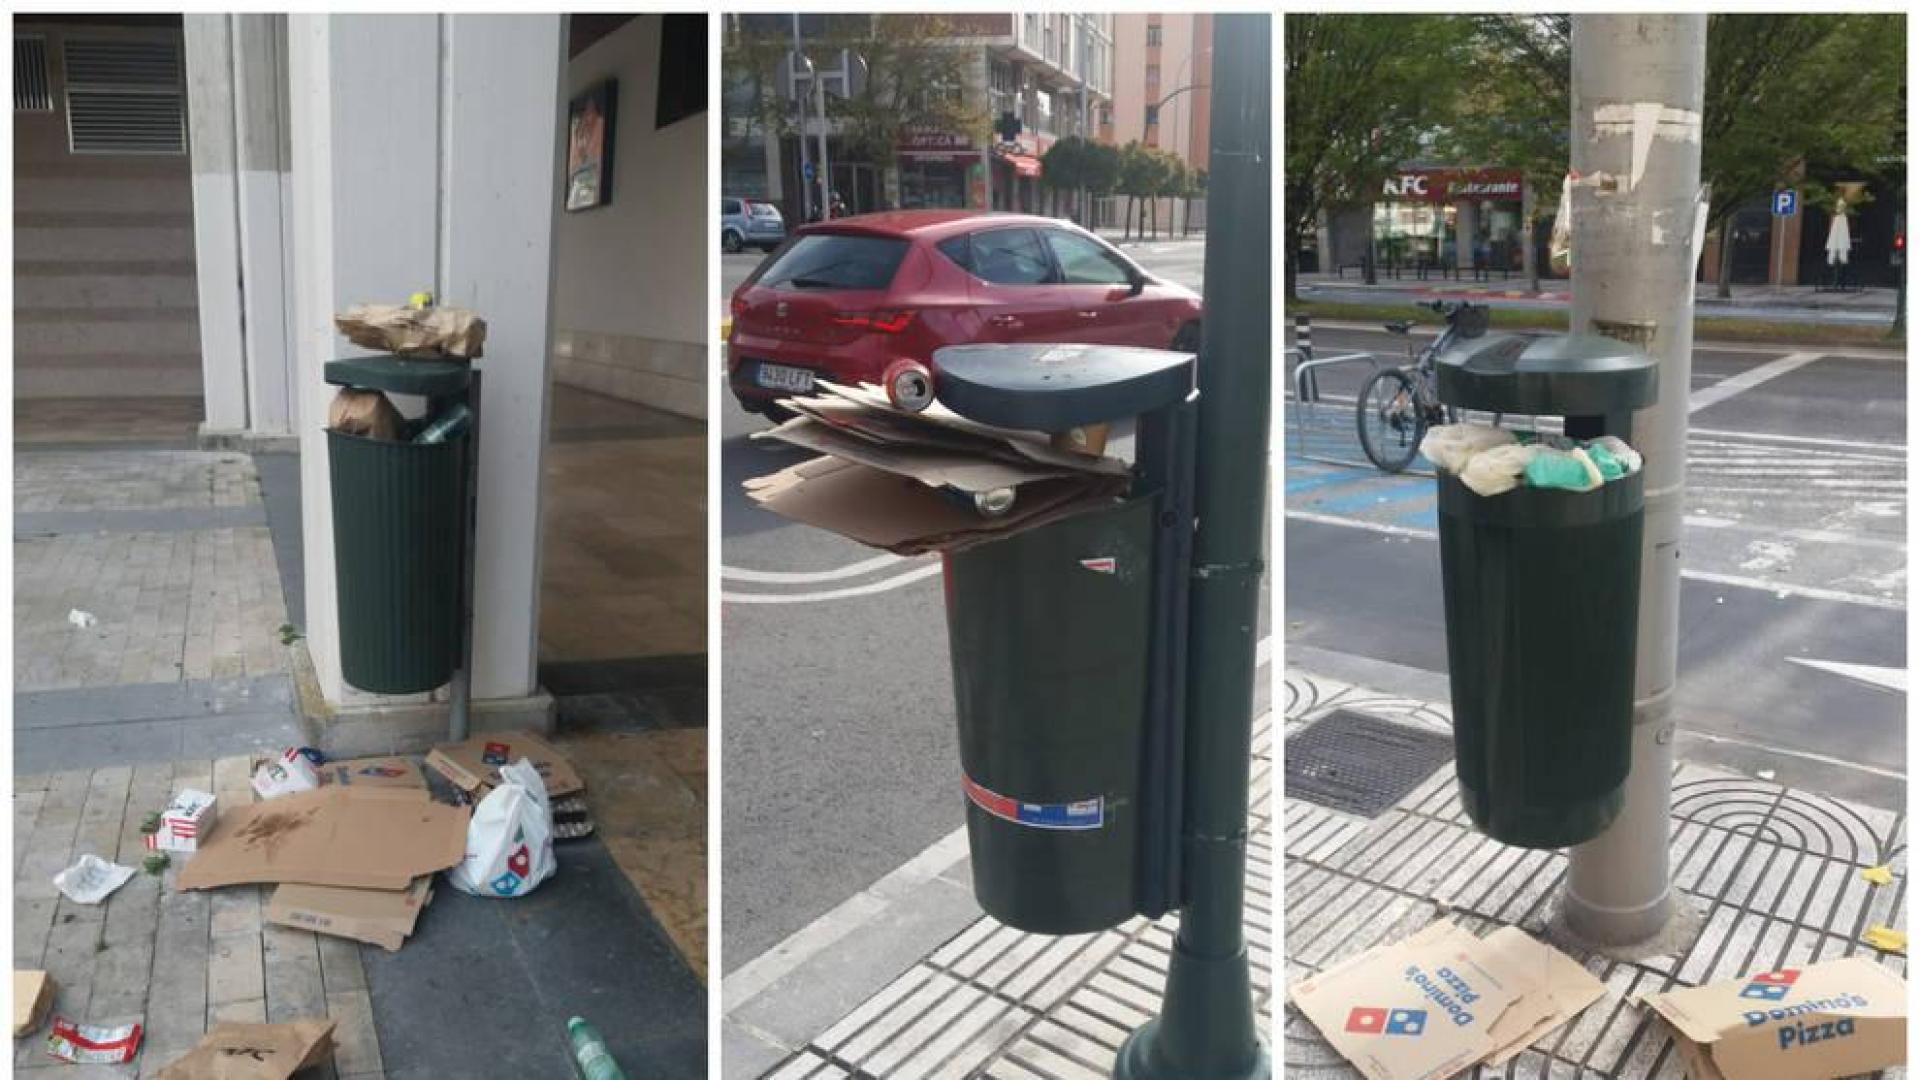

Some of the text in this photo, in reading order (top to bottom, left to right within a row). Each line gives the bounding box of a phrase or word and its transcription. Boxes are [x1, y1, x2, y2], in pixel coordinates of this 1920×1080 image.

[1778, 193, 1791, 213] P
[1405, 964, 1475, 1027] Domino's
[1743, 991, 1868, 1026] Domino's
[1778, 1018, 1855, 1050] Pizza
